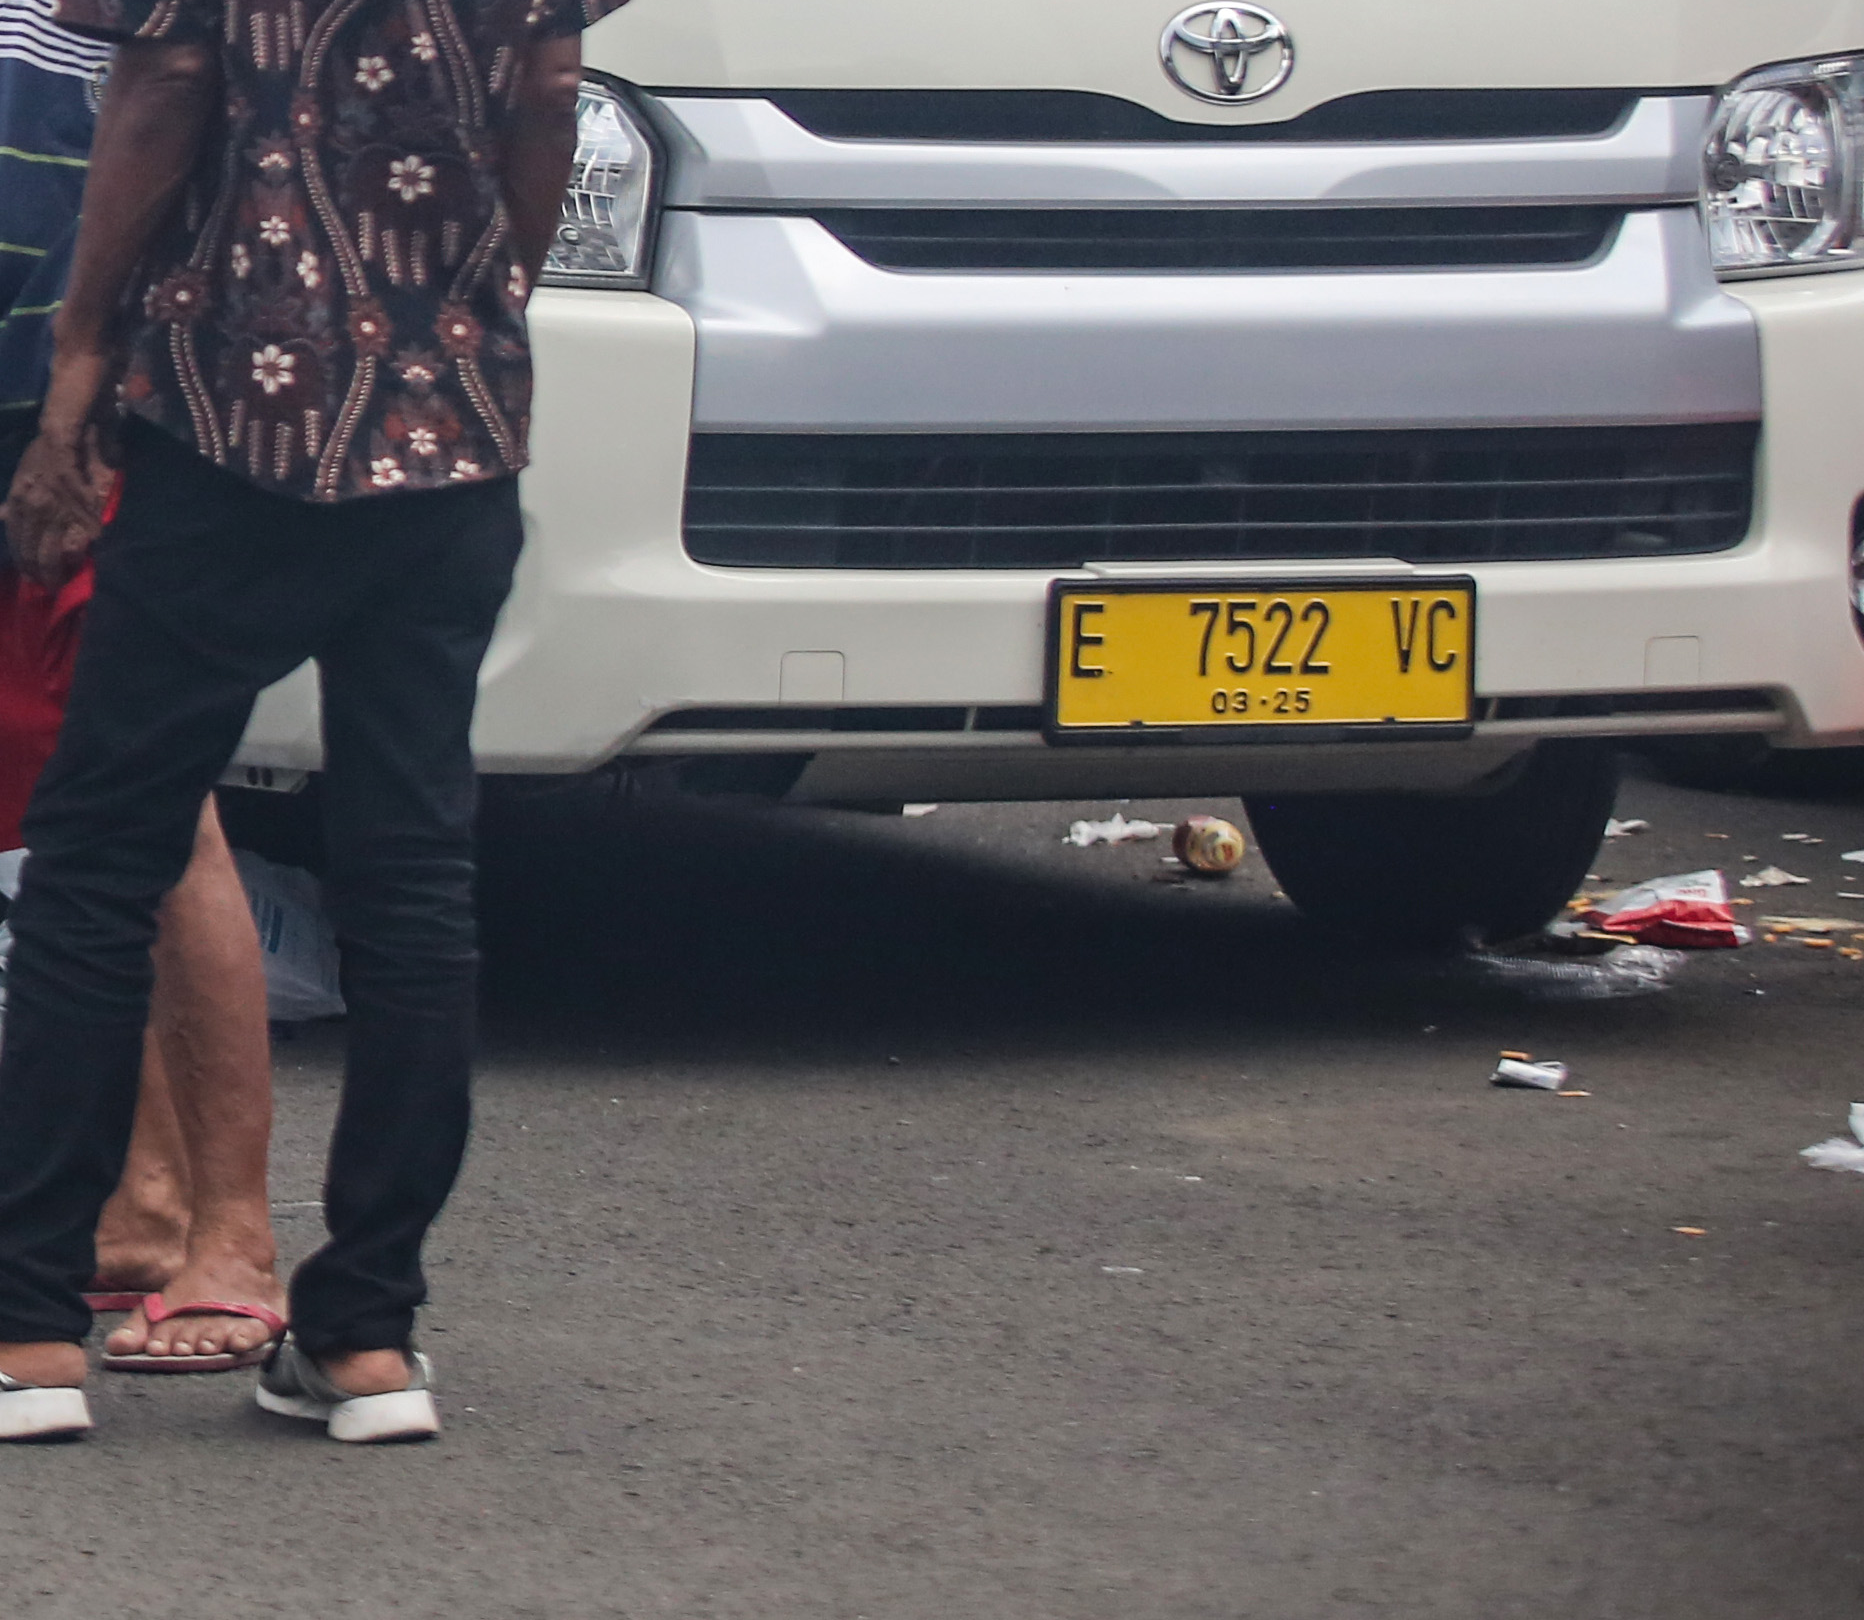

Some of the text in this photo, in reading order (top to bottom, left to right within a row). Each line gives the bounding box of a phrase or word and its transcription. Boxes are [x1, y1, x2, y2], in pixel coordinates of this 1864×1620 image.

[1071, 597, 1458, 678] E 7522 VC
